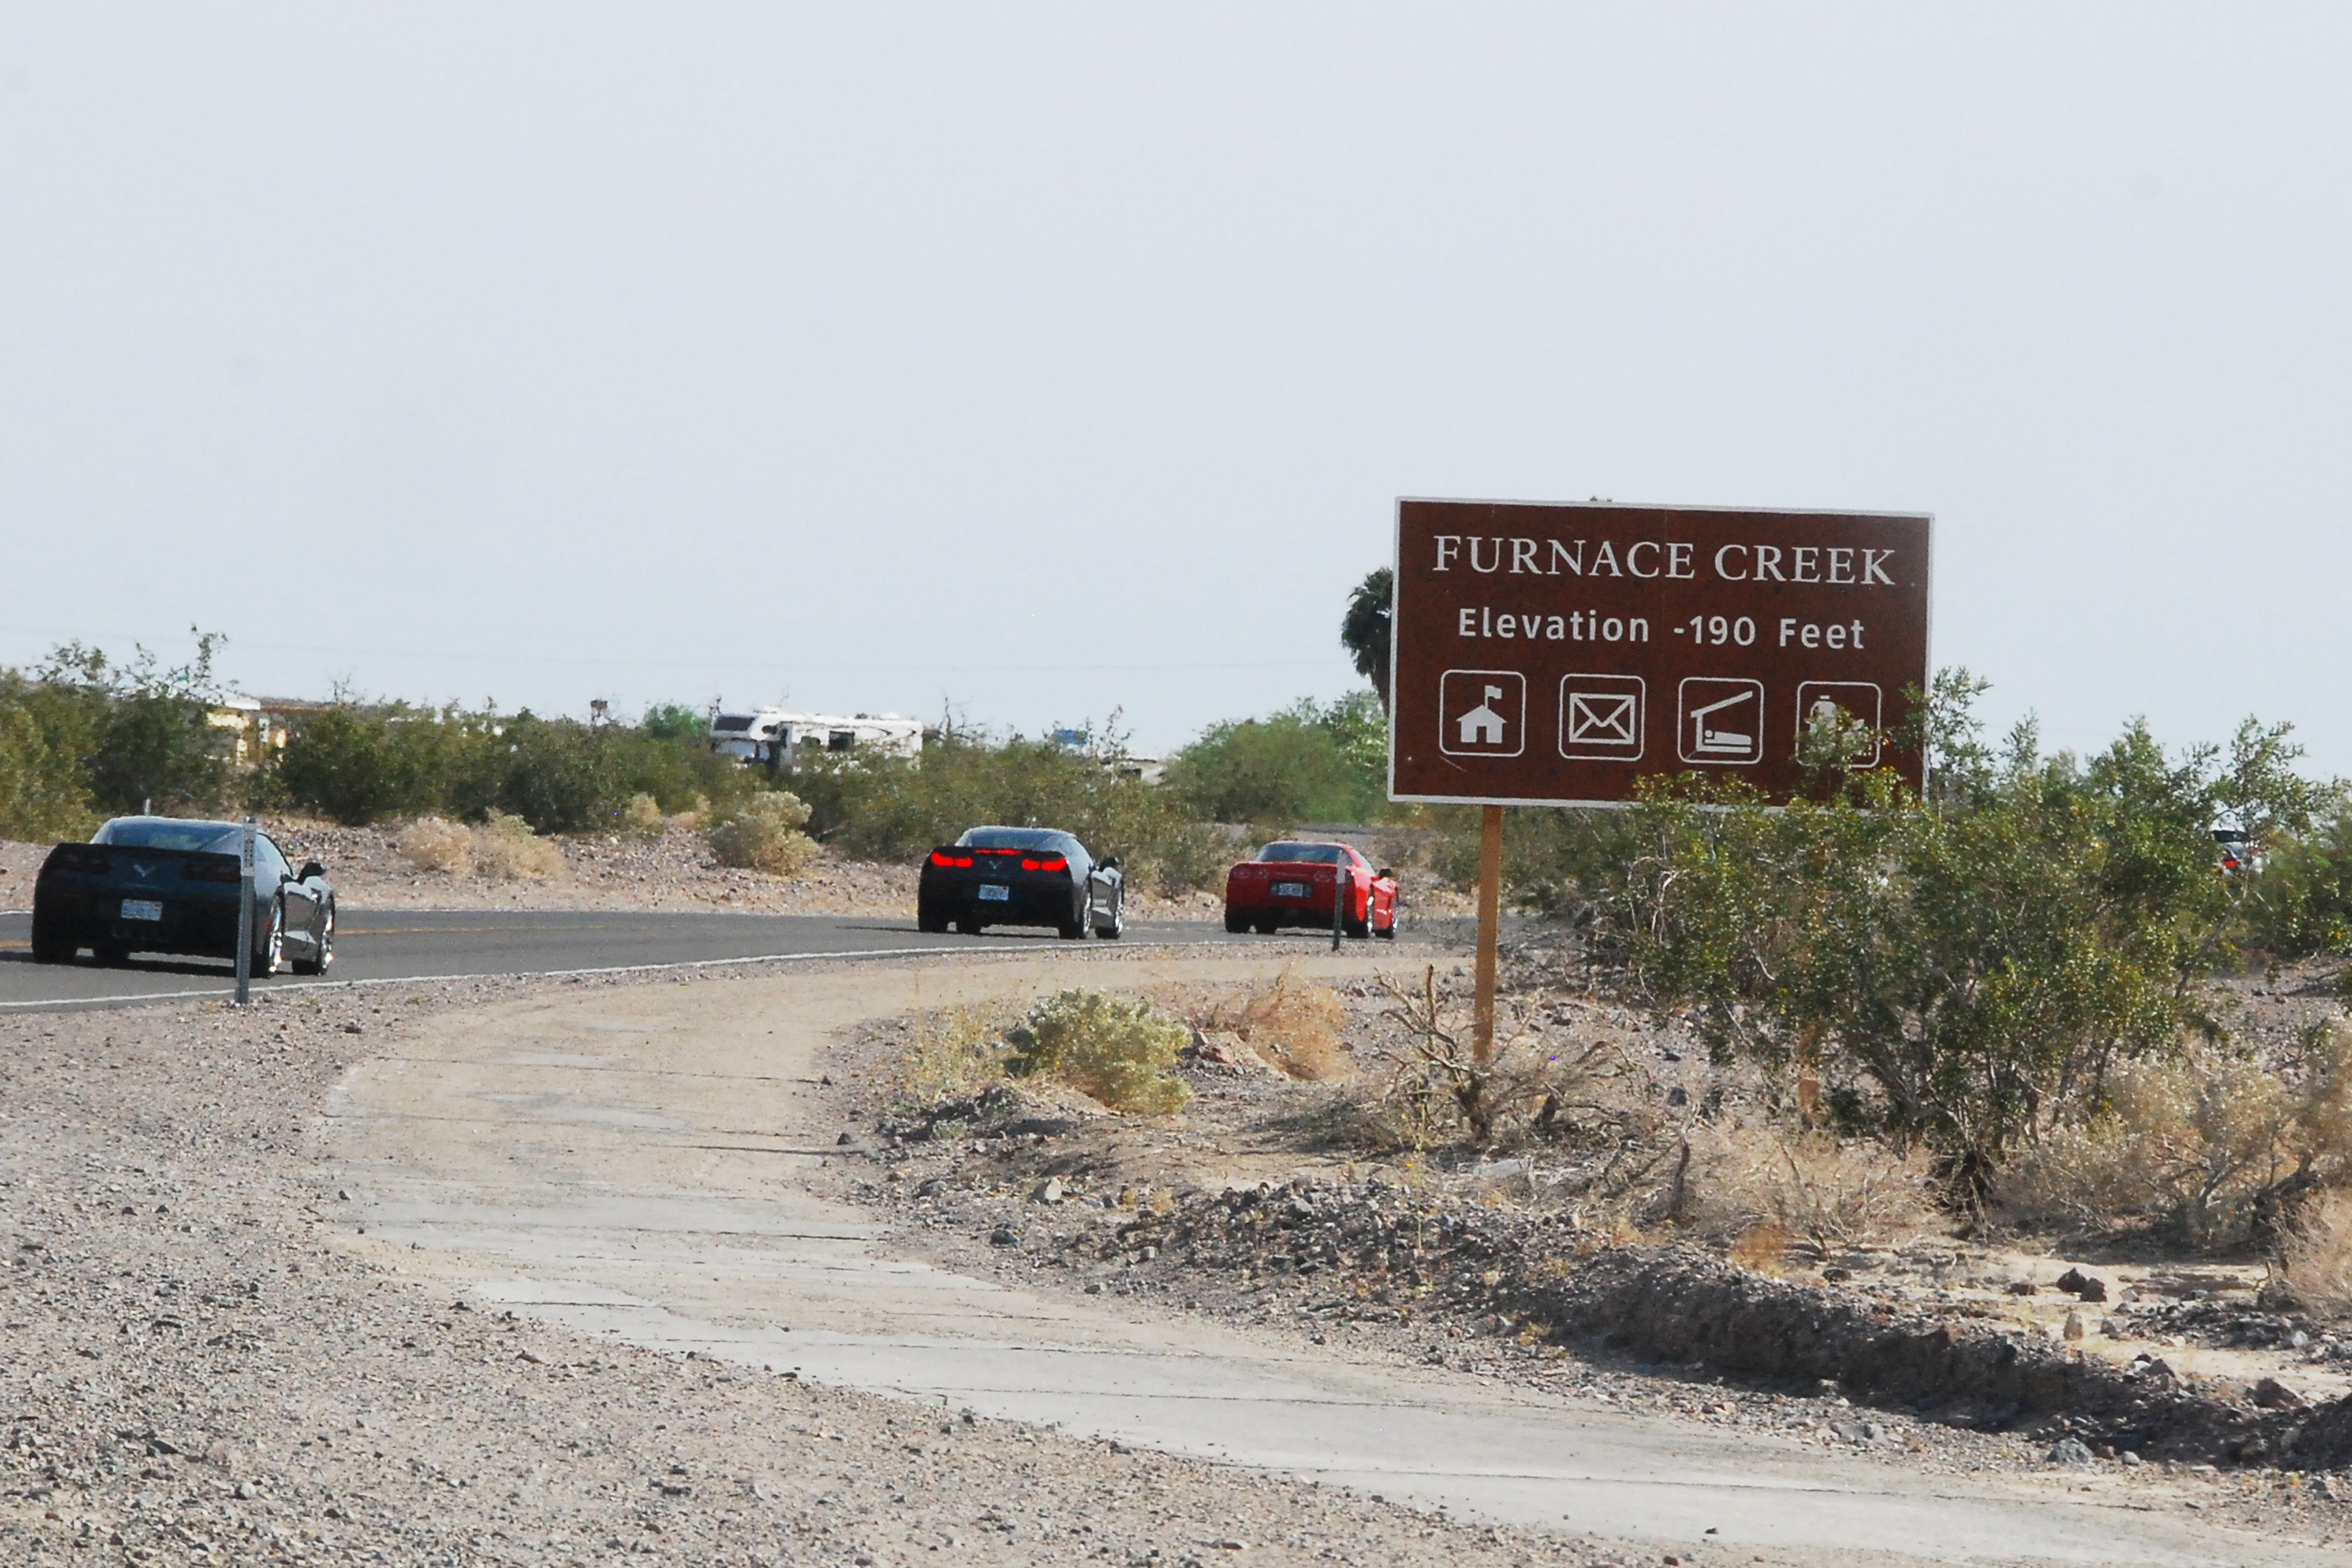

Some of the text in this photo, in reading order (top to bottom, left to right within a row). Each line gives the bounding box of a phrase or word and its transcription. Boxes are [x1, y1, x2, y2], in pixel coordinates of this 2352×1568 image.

[1433, 535, 1895, 585] FURNACE CREEK
[1459, 606, 1864, 649] Elevation -190 Feet
